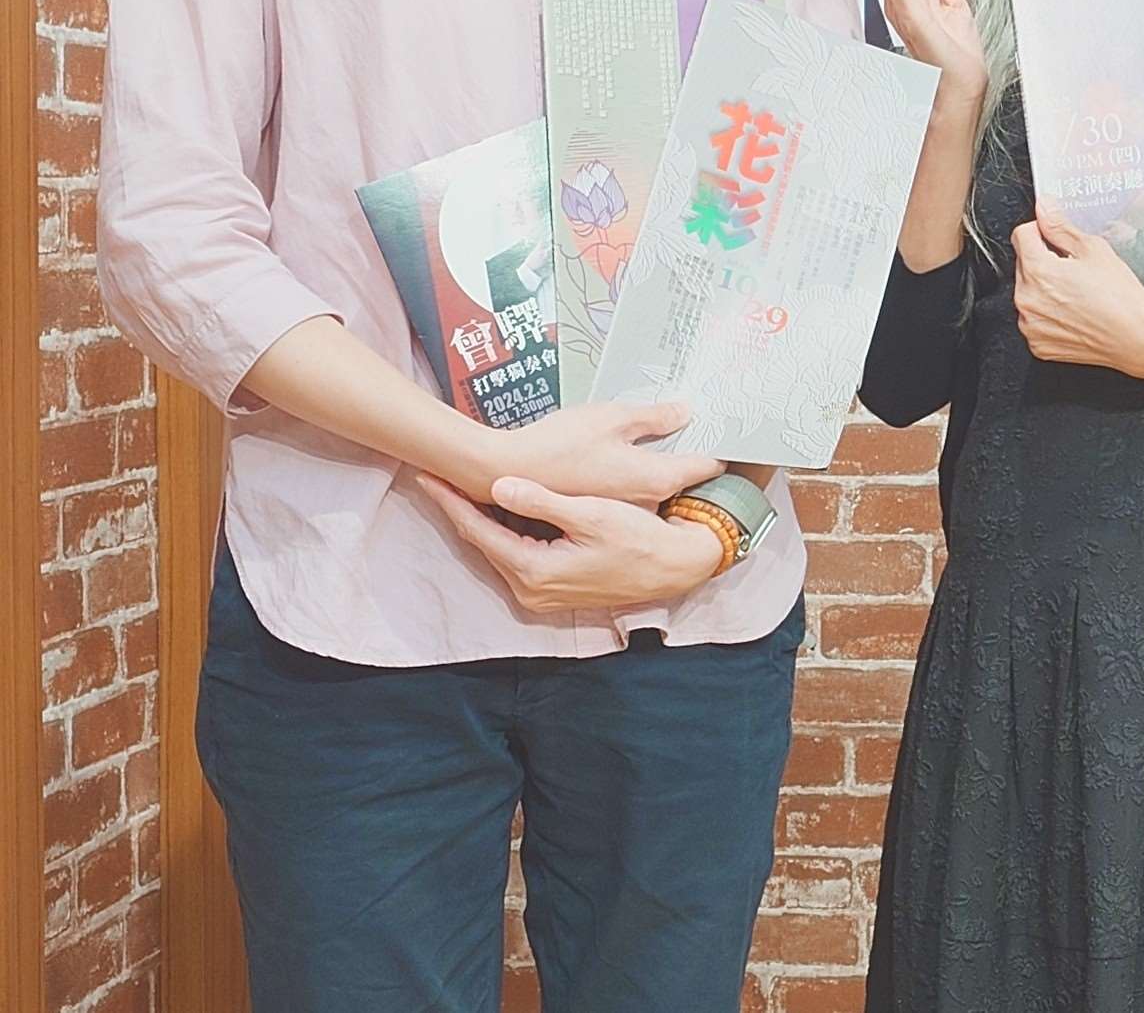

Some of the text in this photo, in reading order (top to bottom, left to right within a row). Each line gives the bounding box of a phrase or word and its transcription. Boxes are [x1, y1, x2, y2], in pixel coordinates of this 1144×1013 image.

[471, 348, 558, 396] 打擊獨奏會
[483, 377, 550, 417] 2024.2.3
[490, 410, 515, 428] Sat.
[511, 394, 555, 419] 7:30pm
